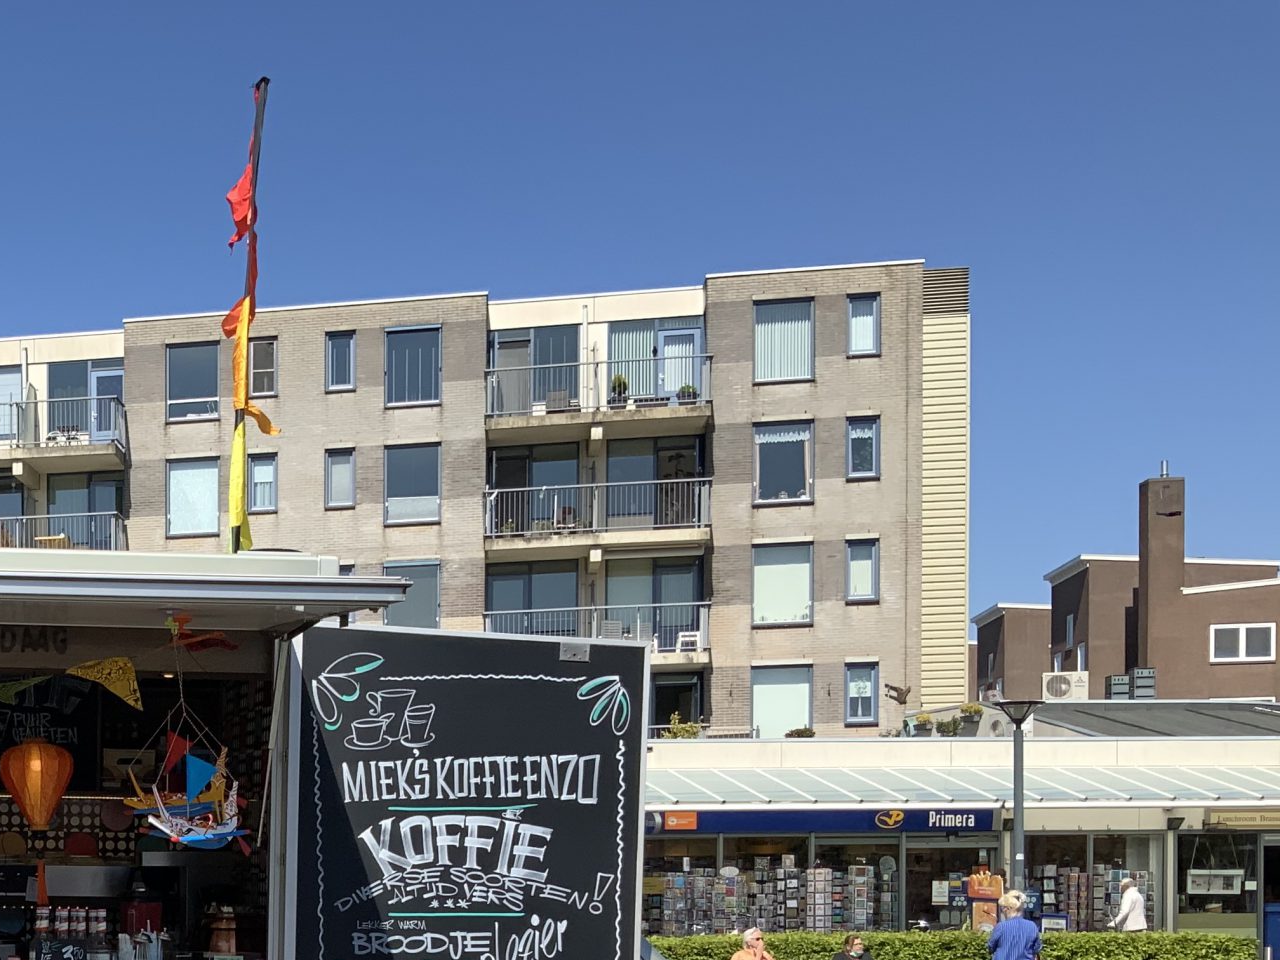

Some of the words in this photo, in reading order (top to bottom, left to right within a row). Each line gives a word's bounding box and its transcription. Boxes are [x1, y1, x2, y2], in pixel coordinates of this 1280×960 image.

[342, 749, 430, 804] MIEK'S
[436, 755, 522, 801] KOFFIE
[523, 754, 601, 804] ENZO
[929, 811, 975, 827] Primera
[358, 815, 554, 882] KOFFIE
[463, 883, 525, 911] VERS
[357, 919, 394, 930] LEKKER
[398, 919, 427, 930] WARM
[351, 931, 493, 960] BROODJE
